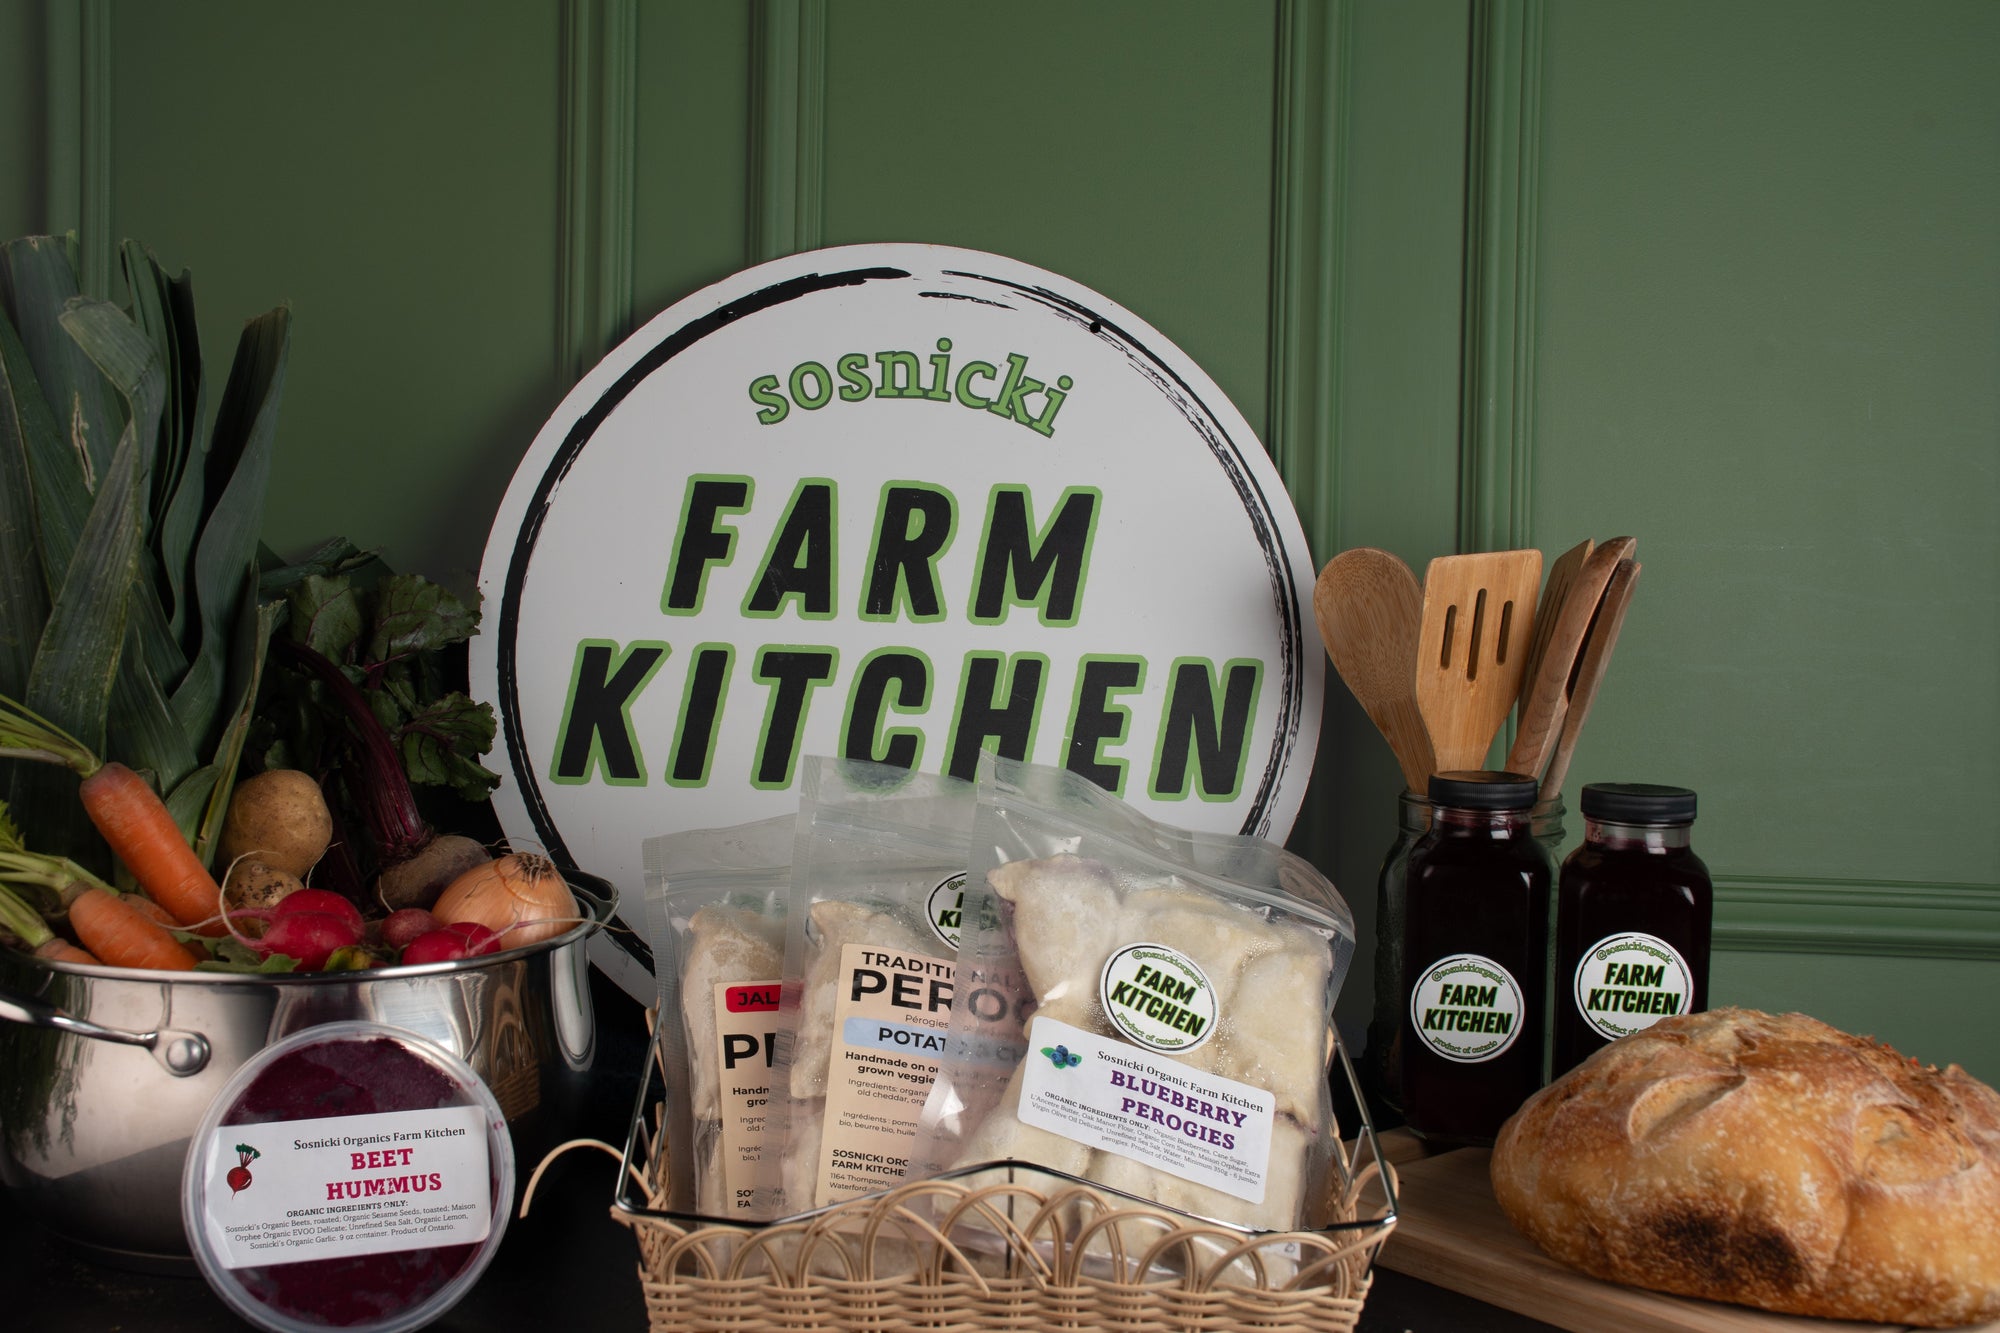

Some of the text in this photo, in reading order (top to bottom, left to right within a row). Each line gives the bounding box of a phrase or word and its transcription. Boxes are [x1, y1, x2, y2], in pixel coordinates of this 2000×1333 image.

[748, 338, 1074, 439] sosnicki
[660, 474, 1102, 627] FARM
[549, 638, 1265, 803] KITCHEN
[1134, 964, 1197, 1006] FARM
[1604, 962, 1665, 988] FARM
[1439, 984, 1498, 1008] FARM
[1587, 988, 1680, 1015] KITCHEN
[1110, 980, 1206, 1037] KITCHEN
[1116, 1012, 1184, 1046] product of ontario
[1423, 1008, 1513, 1034] KITCHEN
[1597, 1018, 1627, 1035] product
[1432, 1037, 1462, 1053] product
[1472, 1041, 1498, 1053] ontario
[846, 1051, 907, 1068] Handmade
[911, 1062, 925, 1071] on
[848, 1078, 898, 1093] Ingredients:
[858, 1066, 936, 1084] grown veggie
[1097, 1050, 1264, 1112] Sosnicki Organic Farm Kitchen
[858, 1089, 925, 1106] old cheddar, org
[1110, 1070, 1247, 1128] BLUEBERRY
[747, 1124, 760, 1132] old
[839, 1119, 916, 1137] bio, beurre bio, huile
[892, 1120, 918, 1128] pomm
[1044, 1091, 1078, 1108] ORGANIC
[1079, 1104, 1128, 1123] INGREDIENTS
[1154, 1128, 1177, 1141] Organic
[1213, 1151, 1228, 1160] Cane
[1121, 1097, 1235, 1150] PEROGIES
[294, 1128, 466, 1150] Sosnicki Organics Farm Kitchen
[1031, 1101, 1050, 1113] Virgin
[1051, 1109, 1067, 1119] Olive
[1068, 1115, 1078, 1124] Oil
[1138, 1137, 1148, 1146] Sea
[1184, 1156, 1212, 1170] Minimum
[1238, 1174, 1257, 1185] jumbo
[1082, 1113, 1094, 1121] Oak
[1096, 1118, 1116, 1127] Manor
[1137, 1130, 1160, 1143] Organic
[1161, 1140, 1175, 1149] Corn
[1198, 1153, 1220, 1165] Maison
[1244, 1168, 1261, 1178] Extra
[1131, 1143, 1153, 1156] Product
[350, 1148, 413, 1170] BEET
[832, 1149, 883, 1163] SOSNICKI
[830, 1172, 845, 1180] 1164
[832, 1160, 906, 1177] FARM KITCHE
[326, 1173, 442, 1200] HUMMUS
[829, 1182, 867, 1192] Waterford
[225, 1224, 260, 1233] Sosnicki's
[262, 1221, 290, 1231] Organic
[343, 1214, 370, 1222] Organic
[372, 1211, 398, 1219] Sesame
[451, 1203, 476, 1211] Maison
[287, 1200, 409, 1218] ORGANIC INGREDIENTS ONLY:
[235, 1234, 261, 1242] Orphee
[263, 1231, 291, 1239] Organic
[292, 1228, 316, 1236] EVOO
[349, 1221, 382, 1230] Unrefined
[414, 1216, 441, 1224] Organic
[250, 1240, 284, 1250] Sosnicki's
[286, 1238, 314, 1247] Organic
[391, 1227, 418, 1236] Product
